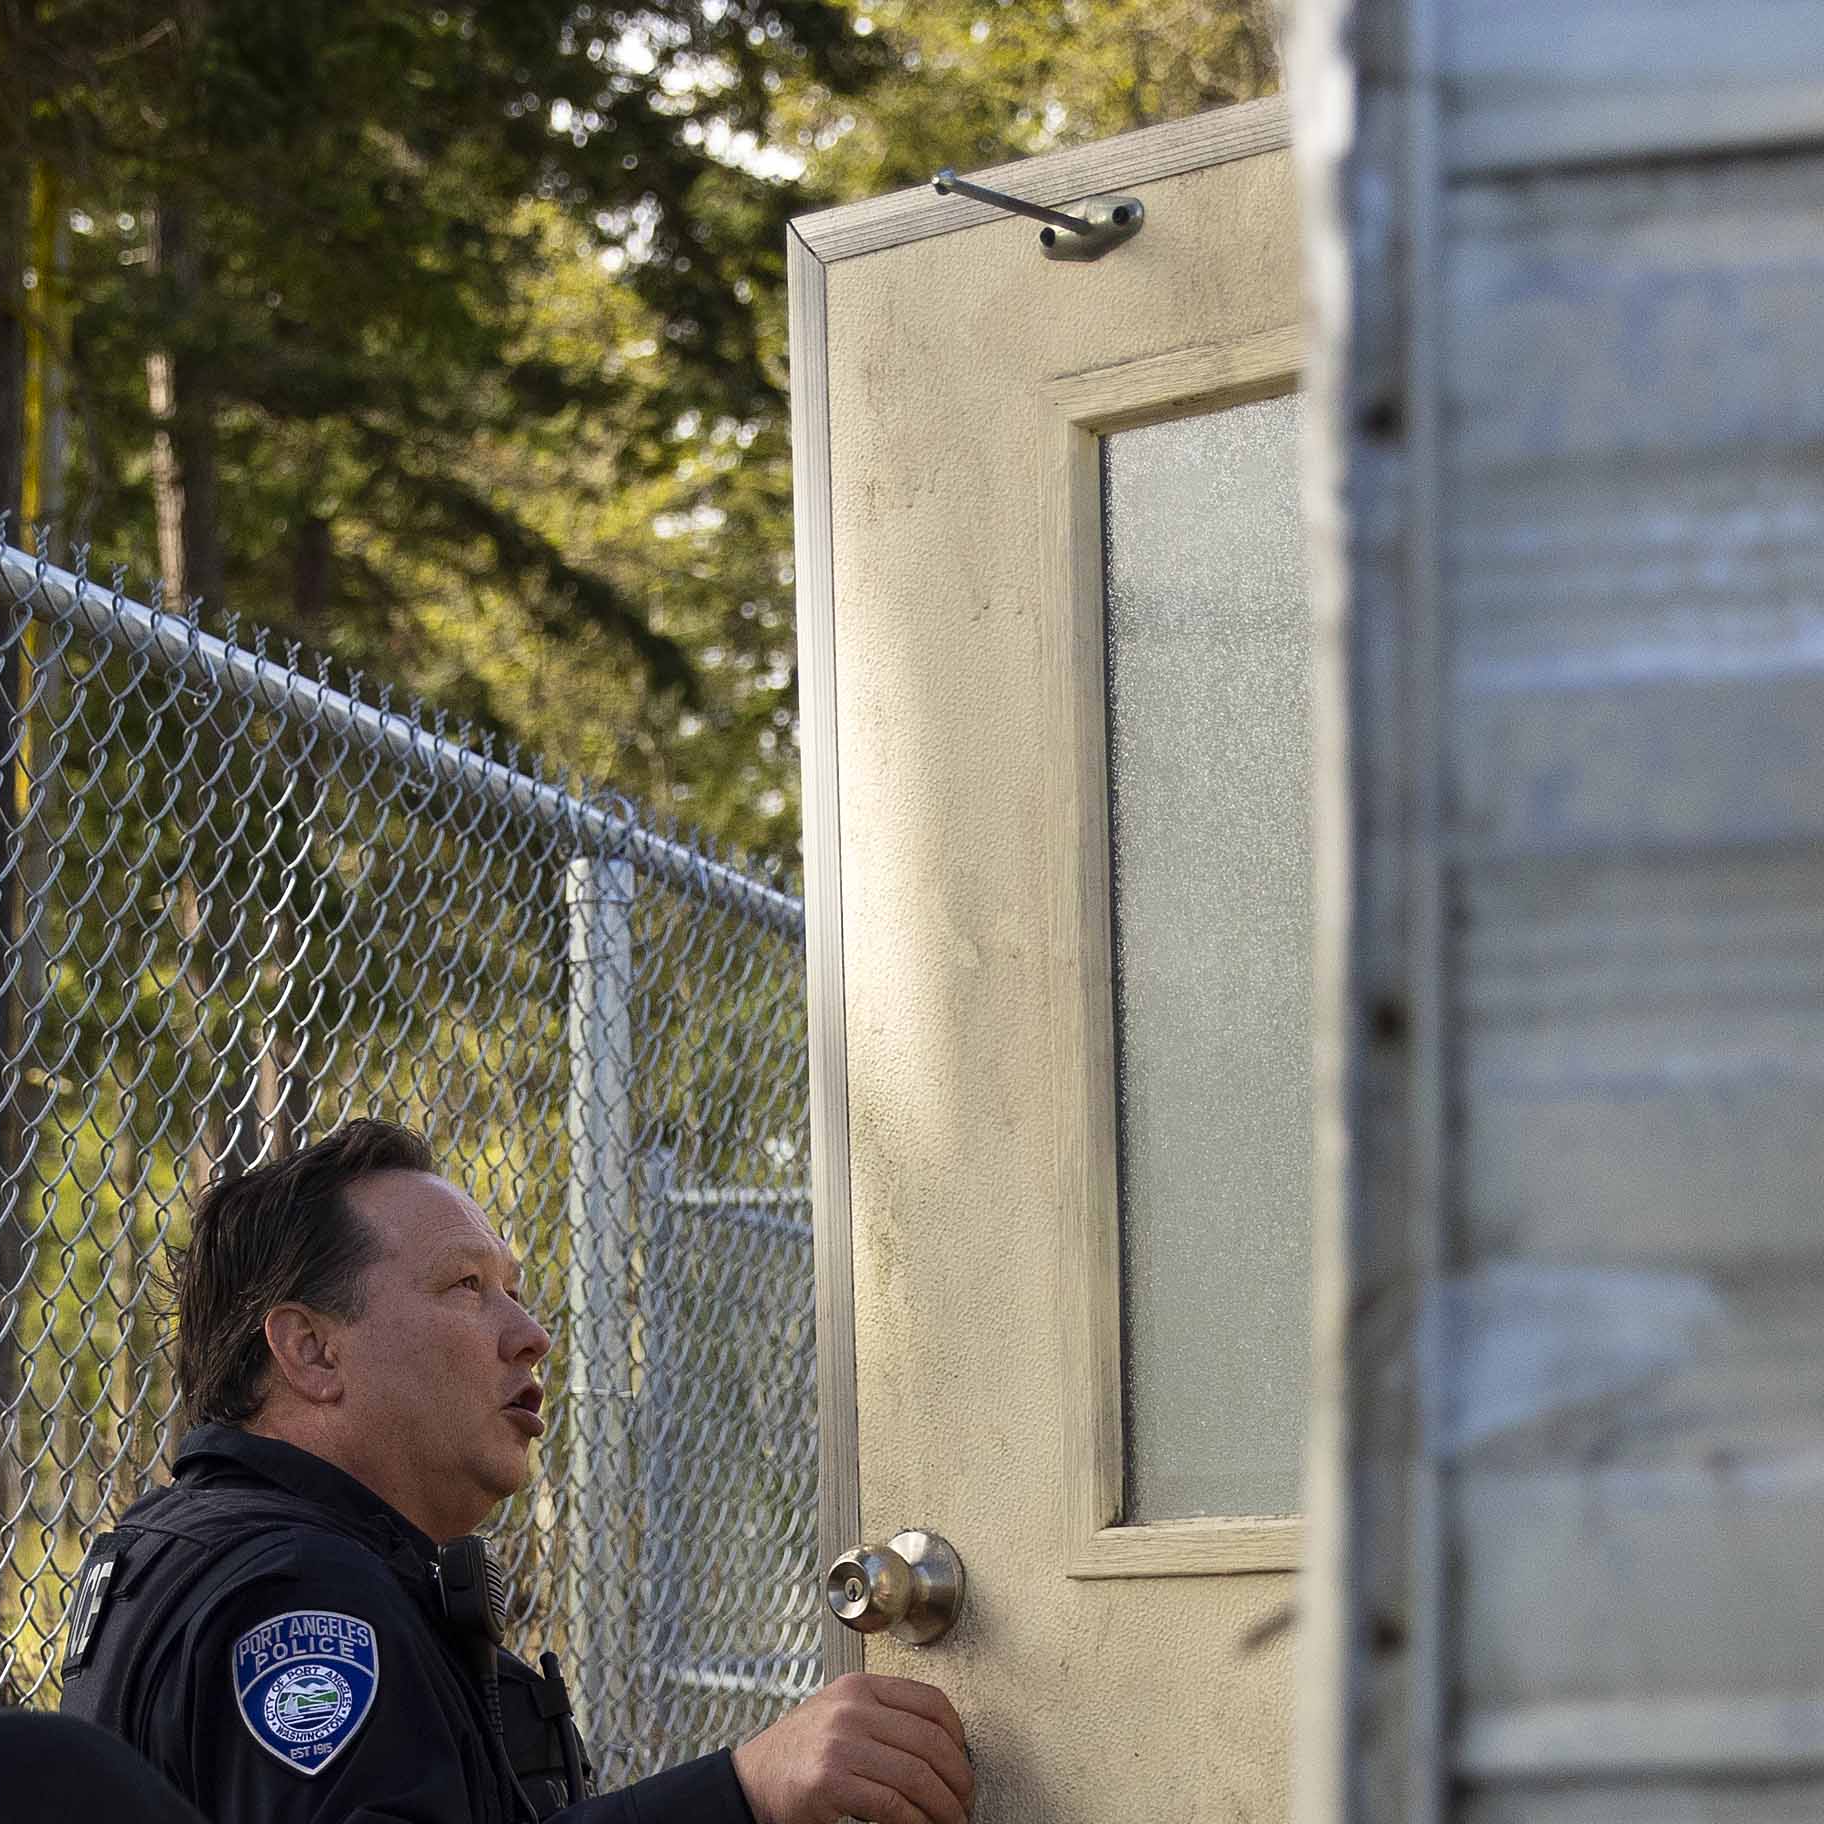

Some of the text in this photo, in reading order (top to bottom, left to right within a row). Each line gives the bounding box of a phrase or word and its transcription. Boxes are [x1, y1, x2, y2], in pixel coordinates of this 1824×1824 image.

[68, 1561, 114, 1658] ICE
[239, 1616, 370, 1667] PORT ANGELES
[256, 1636, 356, 1674] POLICE
[266, 1666, 352, 1722] CITY OF PORT ANGELES
[275, 1715, 345, 1741] WASHINGTON
[290, 1742, 333, 1759] EST 1915
